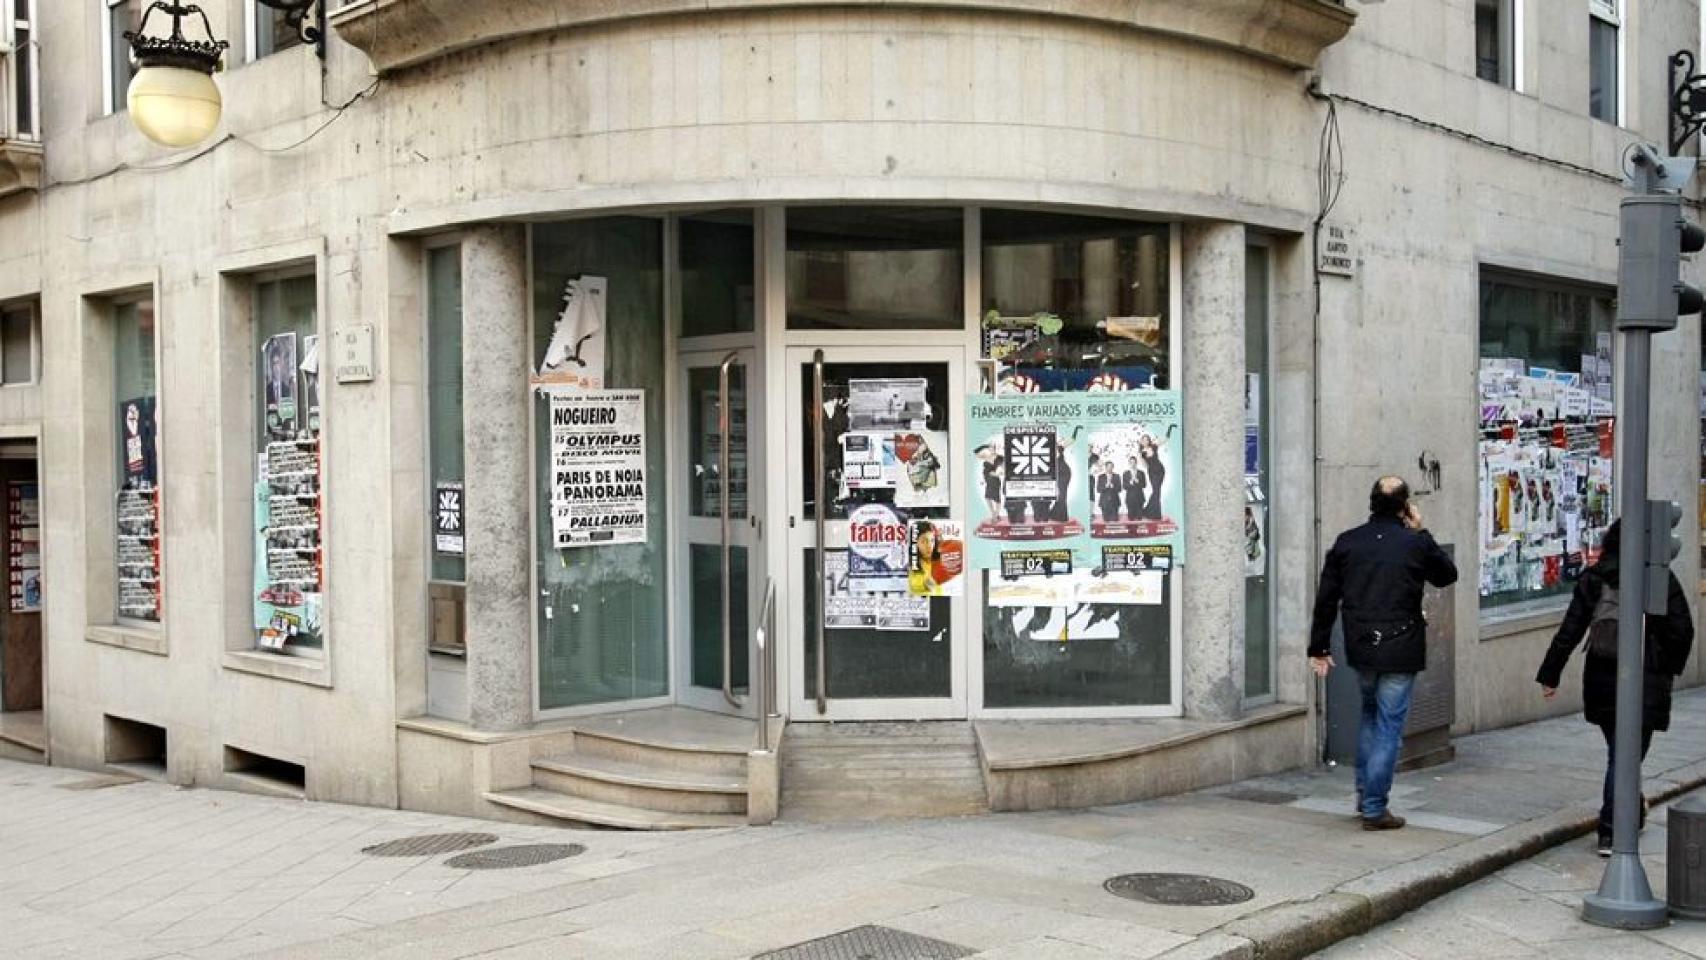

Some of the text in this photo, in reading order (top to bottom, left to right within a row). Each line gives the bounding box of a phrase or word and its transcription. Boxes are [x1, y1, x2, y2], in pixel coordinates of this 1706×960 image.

[554, 407, 617, 425] NOGUEIRO
[971, 403, 1082, 419] FIAMBRES VARIADOS
[1122, 402, 1176, 416] VARIADOS
[566, 434, 641, 447] OLYMPUS
[557, 468, 643, 486] PARIS DE NOIA
[564, 484, 643, 500] PANORAMA
[570, 513, 644, 528] PALLADIUM
[1026, 558, 1044, 571] 02
[1127, 552, 1145, 566] 02
